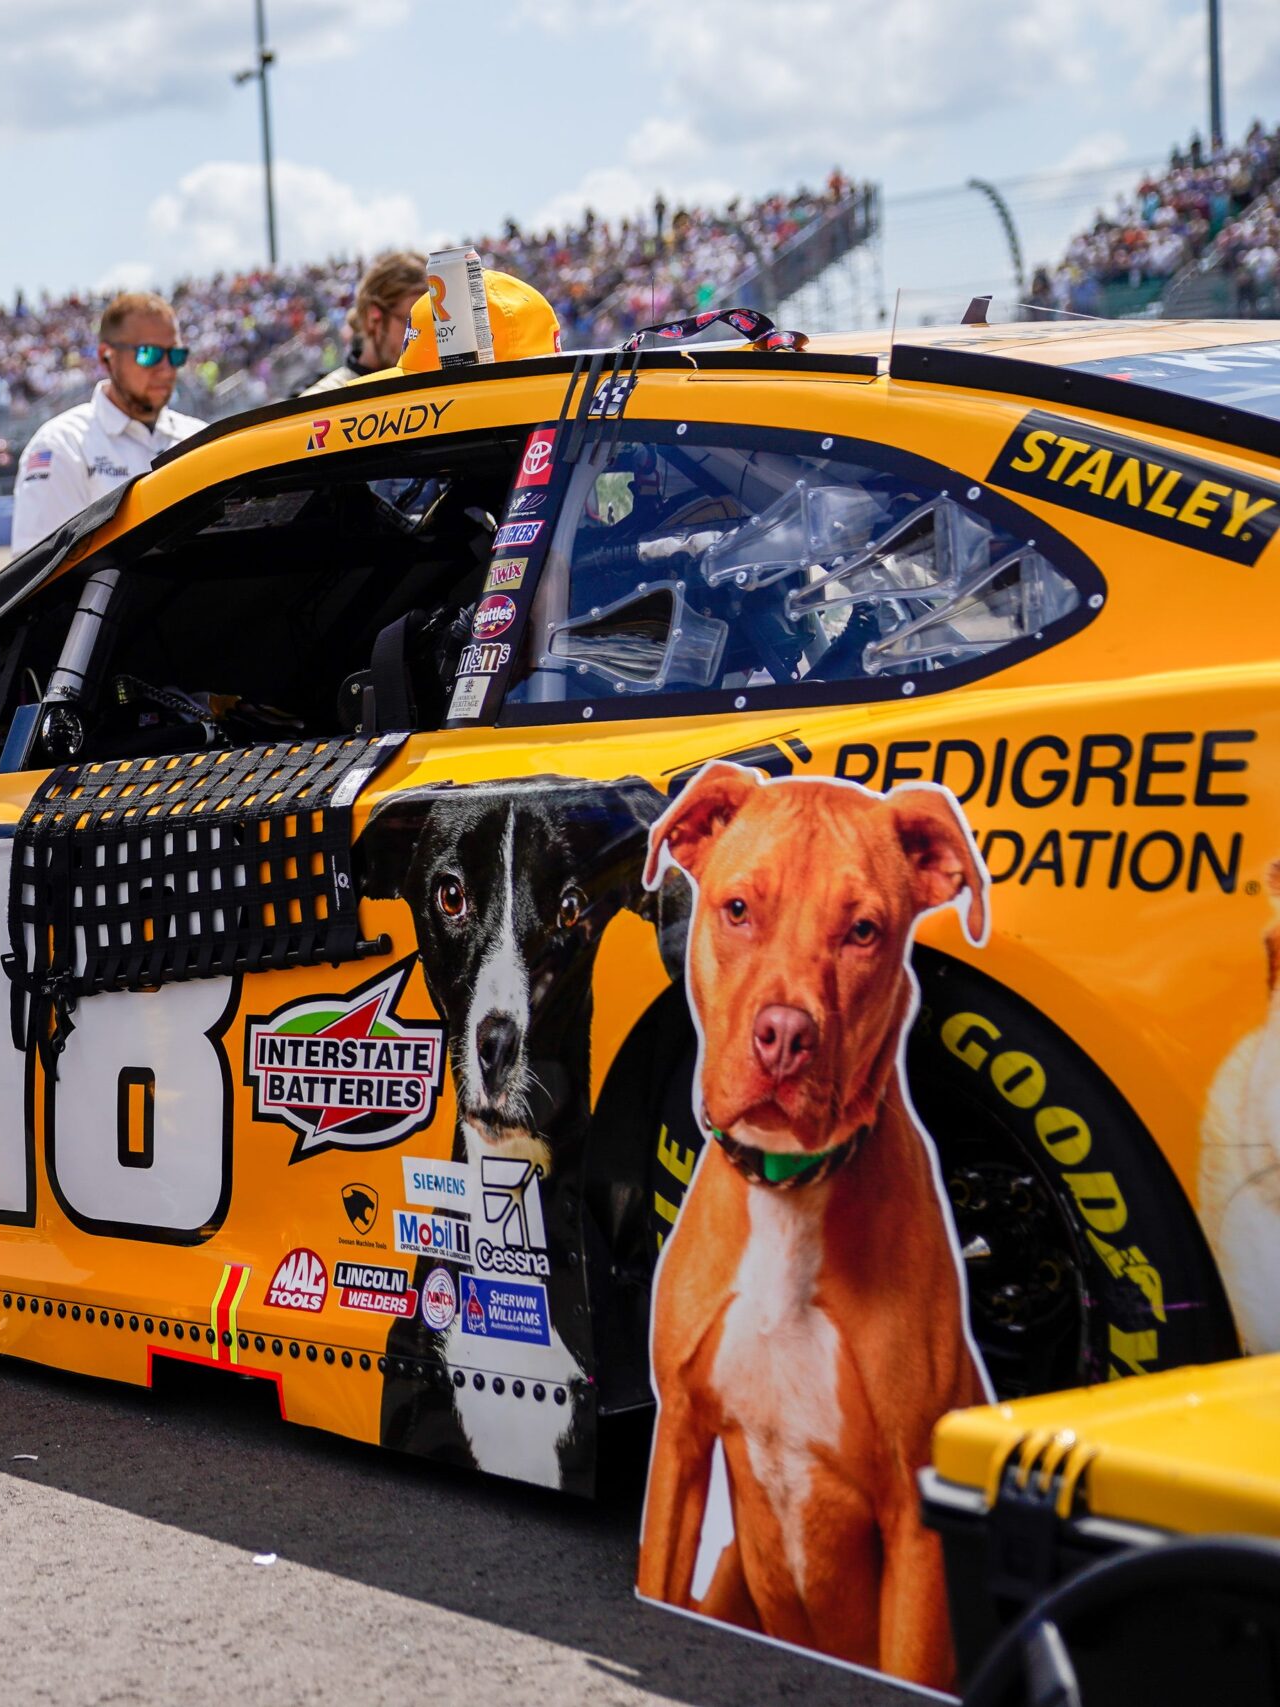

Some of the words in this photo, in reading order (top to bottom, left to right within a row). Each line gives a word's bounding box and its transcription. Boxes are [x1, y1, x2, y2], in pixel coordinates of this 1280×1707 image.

[340, 400, 455, 443] ROWDY
[1010, 430, 1278, 538] STANLEY
[494, 523, 538, 546] SNICKERS
[978, 829, 1244, 893] DATION
[259, 1038, 431, 1072] INTERSTATE
[269, 1074, 422, 1108] BATTERIES
[413, 1173, 466, 1196] SIEMENS
[356, 1240, 374, 1248] Machine
[375, 1242, 387, 1250] Tools
[399, 1214, 453, 1251] Mobil
[400, 1243, 420, 1252] OFFICIAL
[422, 1246, 438, 1254] MOTOR
[476, 1238, 550, 1276] Cessna
[272, 1252, 325, 1295] MAC
[337, 1266, 404, 1293] LINCOLN
[270, 1290, 322, 1310] TOOLS
[348, 1291, 407, 1313] WELDERS
[489, 1290, 537, 1310] SHERWIN
[488, 1305, 541, 1326] WILLIAMS
[491, 1322, 520, 1333] Automotive
